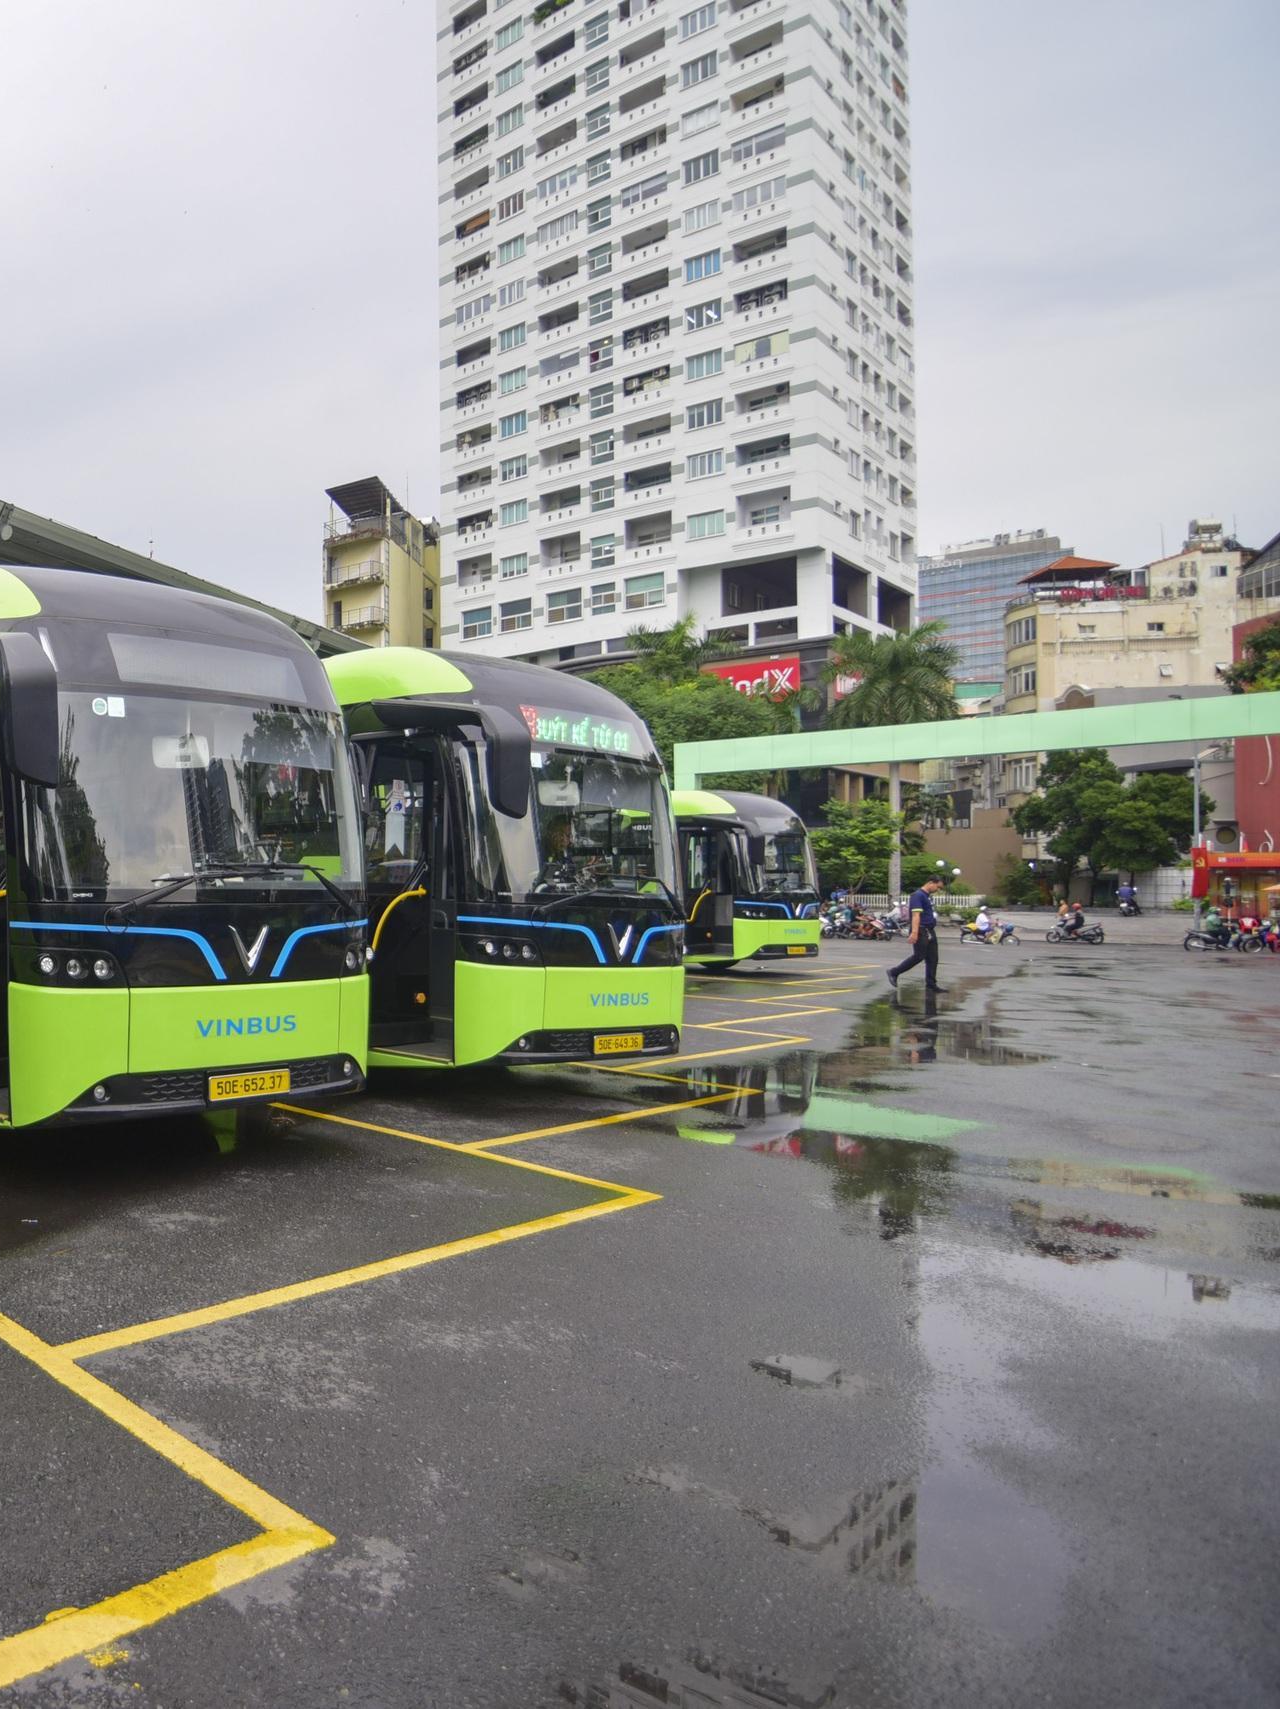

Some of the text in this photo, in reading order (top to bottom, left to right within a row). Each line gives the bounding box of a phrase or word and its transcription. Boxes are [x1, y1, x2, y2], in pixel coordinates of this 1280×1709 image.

[590, 992, 649, 1007] VINBUS
[196, 1015, 297, 1037] VINBUS
[216, 1075, 283, 1096] 50E-652.37
